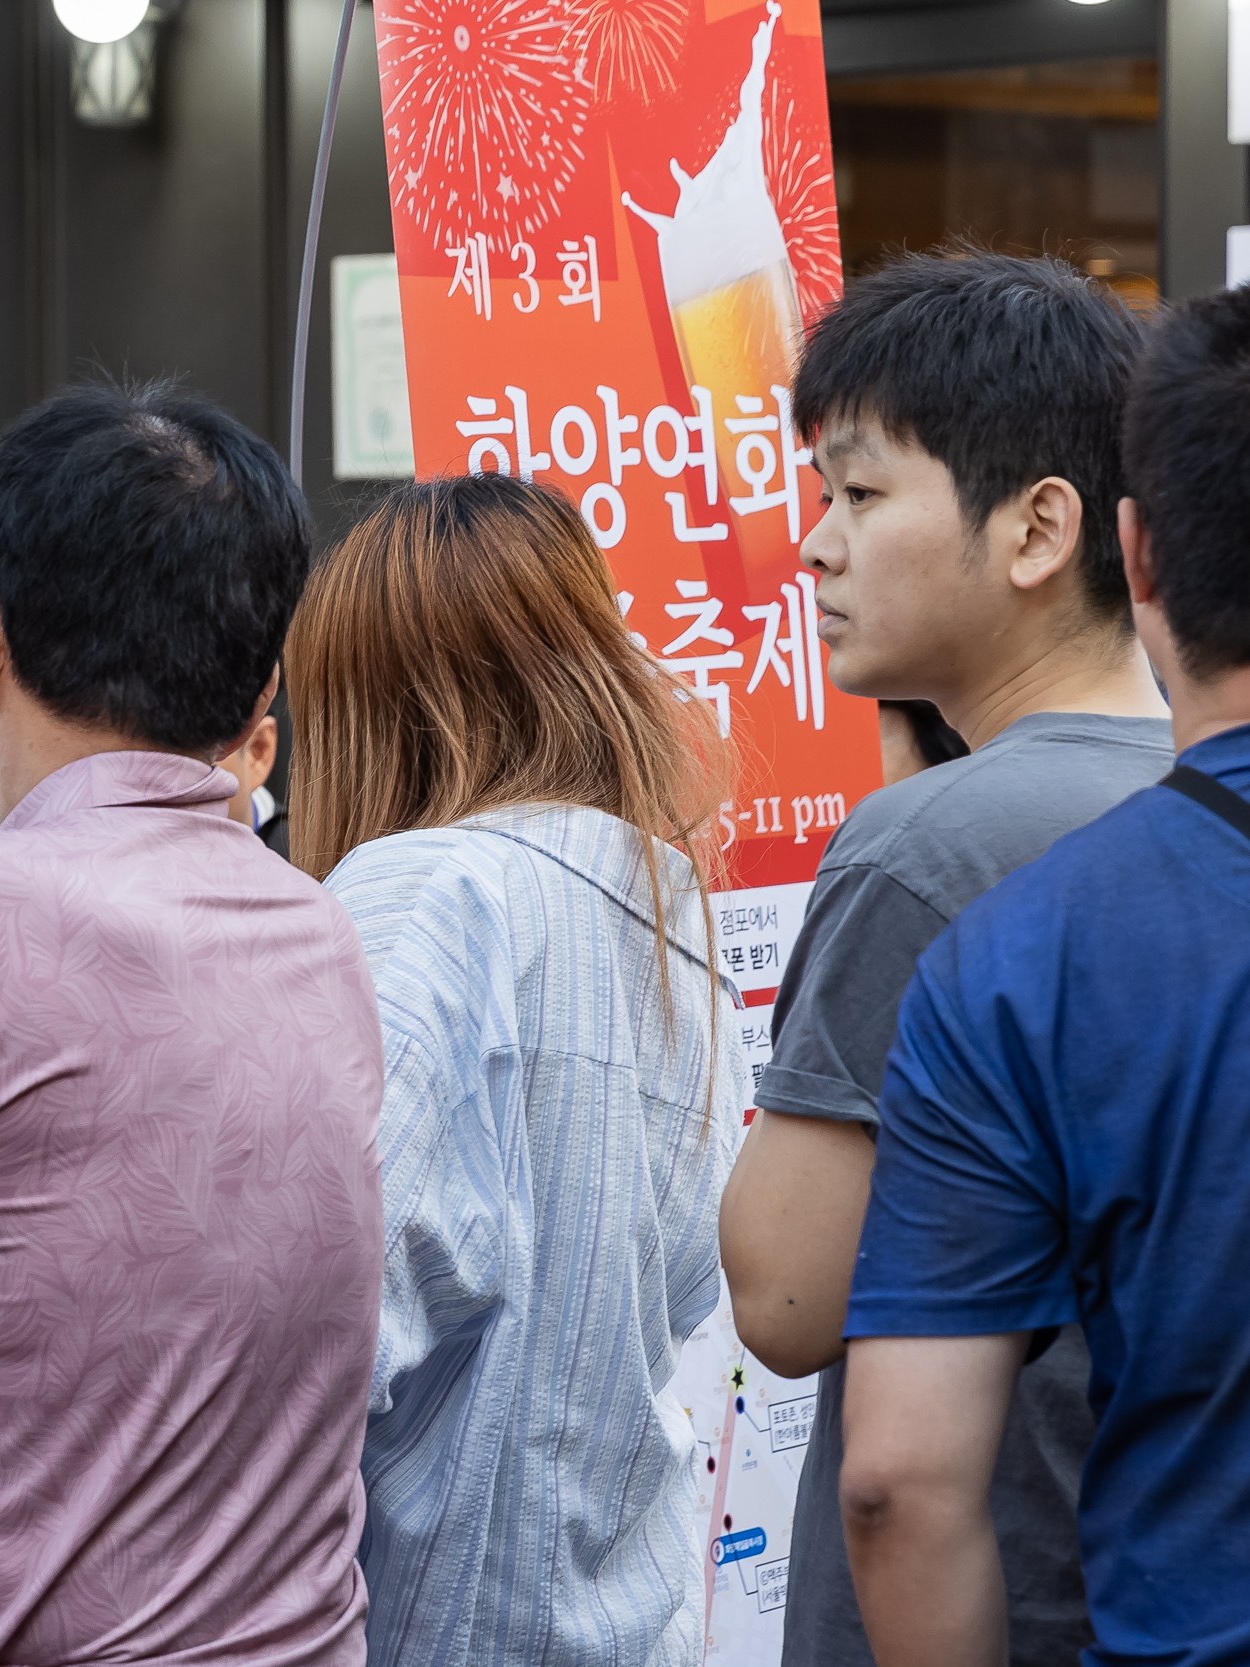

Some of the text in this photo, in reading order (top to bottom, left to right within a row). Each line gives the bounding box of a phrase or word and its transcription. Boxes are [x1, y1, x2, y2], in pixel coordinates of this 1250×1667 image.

[445, 231, 600, 322] 제 3 회
[617, 571, 825, 739] 축제
[791, 791, 847, 844] pm
[720, 903, 779, 936] 점포에서
[750, 942, 779, 970] 받기
